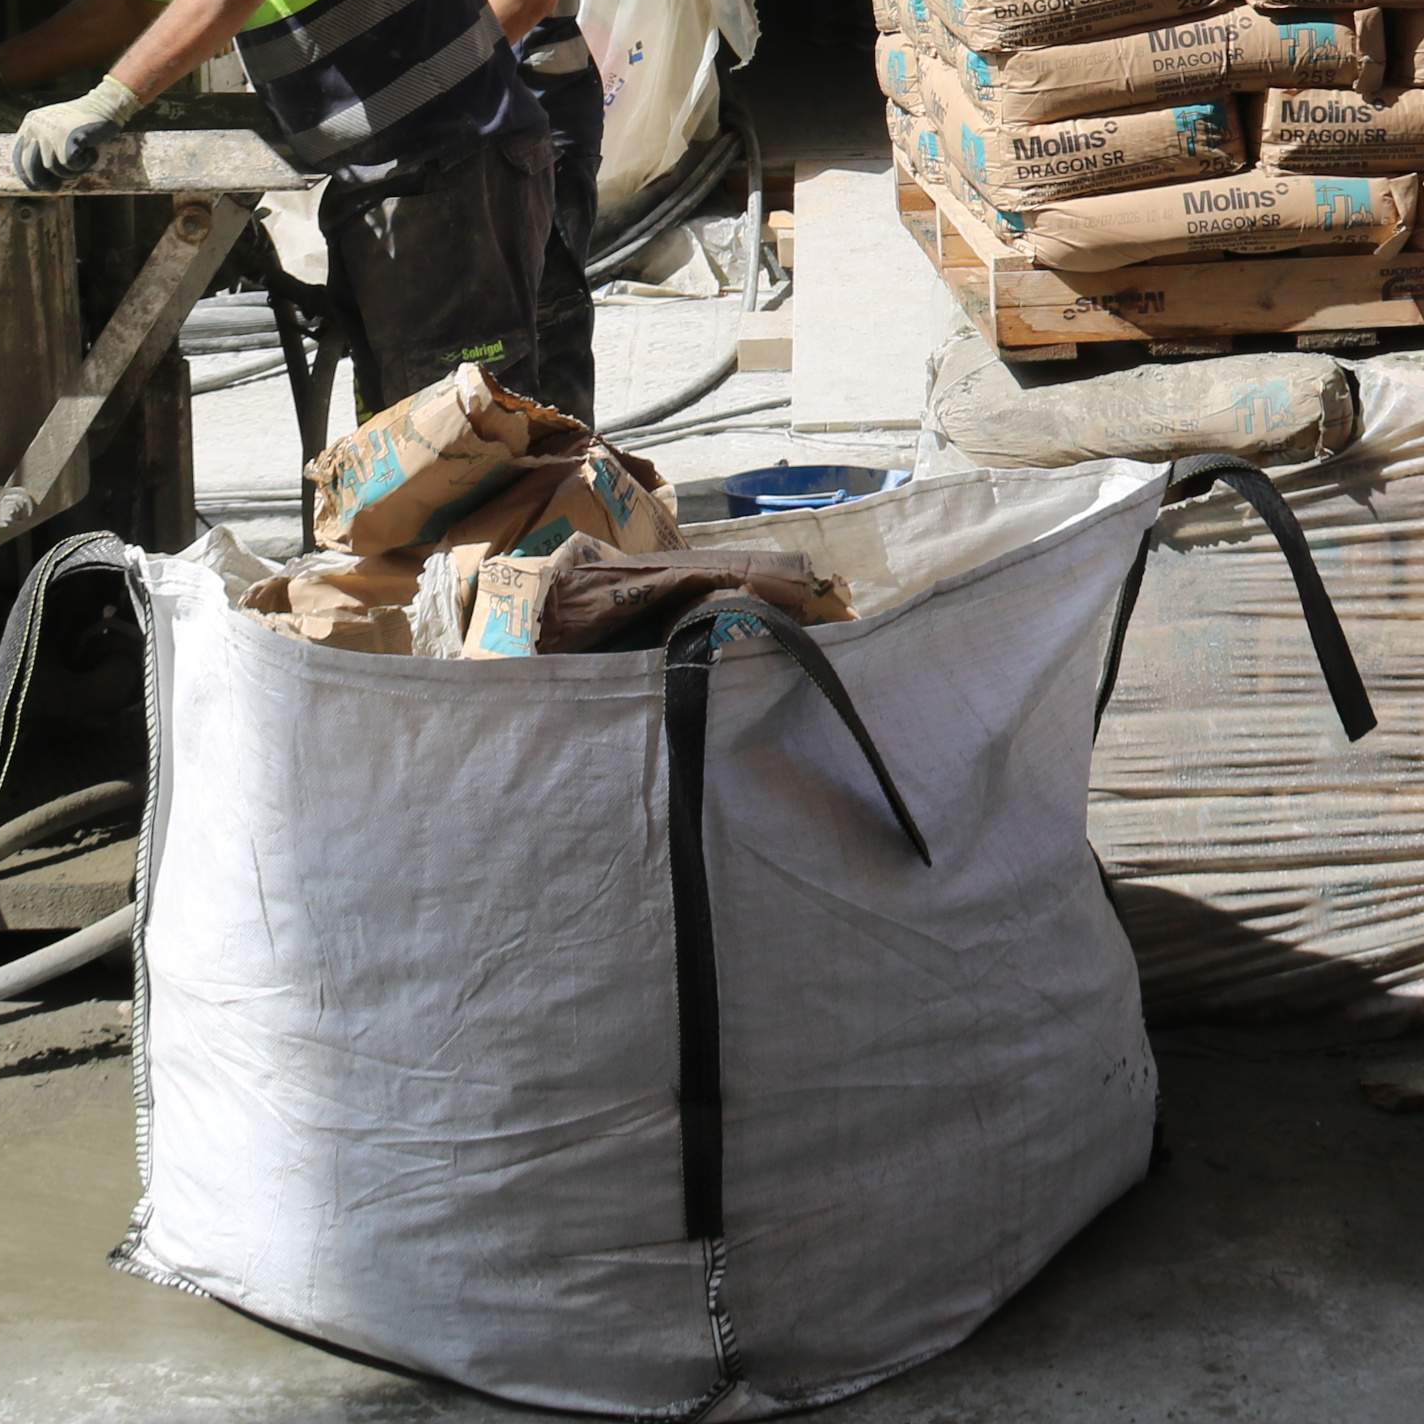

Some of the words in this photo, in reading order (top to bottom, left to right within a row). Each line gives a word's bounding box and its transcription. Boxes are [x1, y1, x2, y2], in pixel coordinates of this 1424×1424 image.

[1148, 21, 1239, 53] Molins
[1153, 50, 1223, 73] DRAGON
[1280, 99, 1372, 124] Molins
[1012, 130, 1107, 160] Molins
[1279, 128, 1361, 144] DRAGON
[1364, 128, 1388, 143] SR
[1016, 155, 1098, 180] DRAGON
[1102, 150, 1126, 165] SR
[1183, 188, 1277, 215] Molins
[1187, 215, 1257, 234] DRAGON
[1260, 214, 1282, 227] SR
